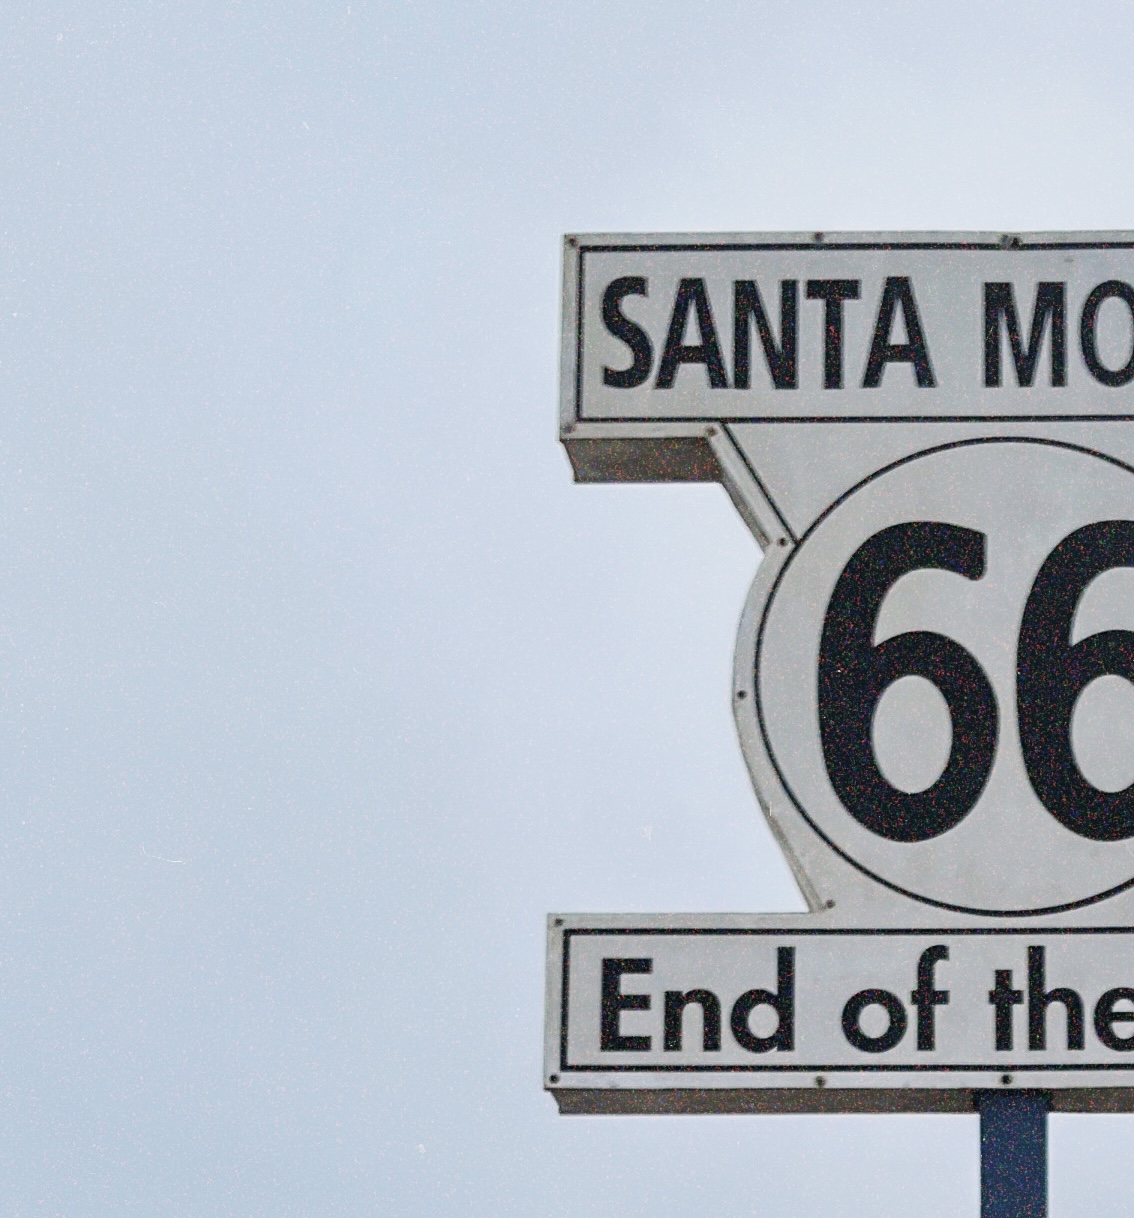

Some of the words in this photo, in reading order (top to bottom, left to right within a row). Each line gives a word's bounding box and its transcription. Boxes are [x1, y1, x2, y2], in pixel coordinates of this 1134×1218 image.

[602, 276, 935, 389] SANTA
[601, 946, 796, 1053] End
[841, 945, 950, 1053] of
